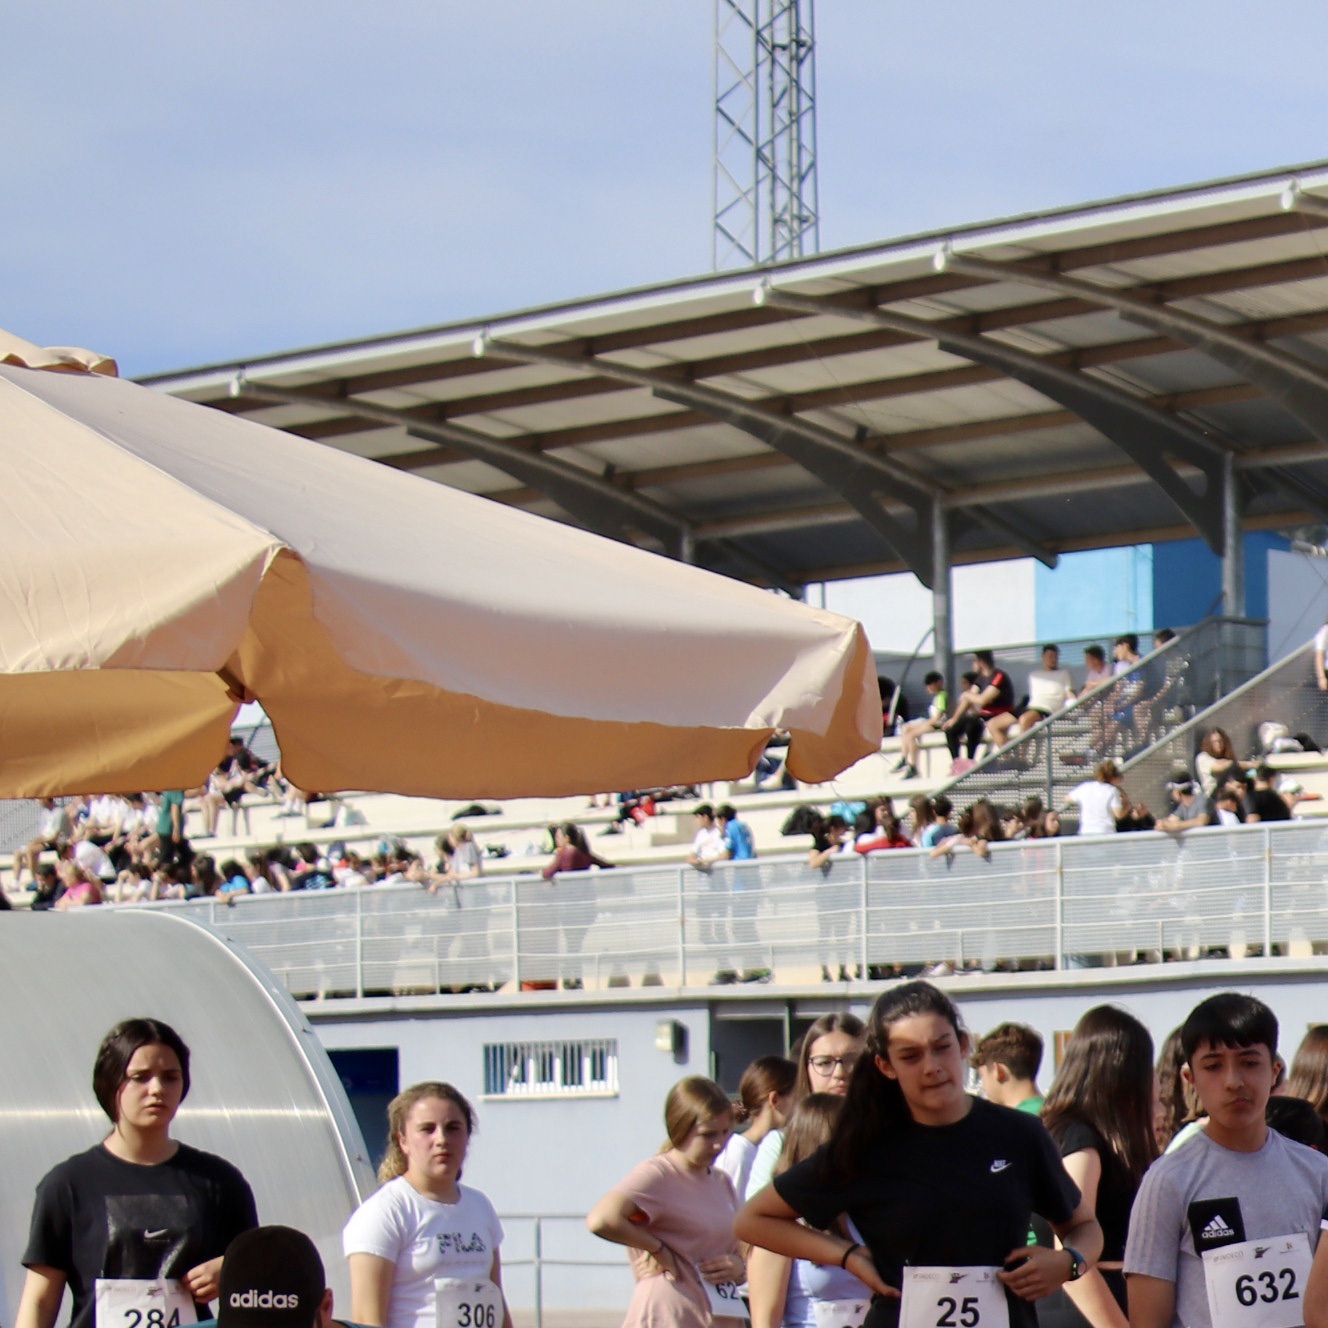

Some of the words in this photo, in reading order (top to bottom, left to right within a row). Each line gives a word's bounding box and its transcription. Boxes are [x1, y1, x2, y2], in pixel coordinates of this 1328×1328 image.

[1202, 1228, 1235, 1239] adidas
[230, 1290, 299, 1308] adidas
[1235, 1267, 1300, 1307] 632
[457, 1303, 496, 1328] 306
[936, 1297, 980, 1328] 25
